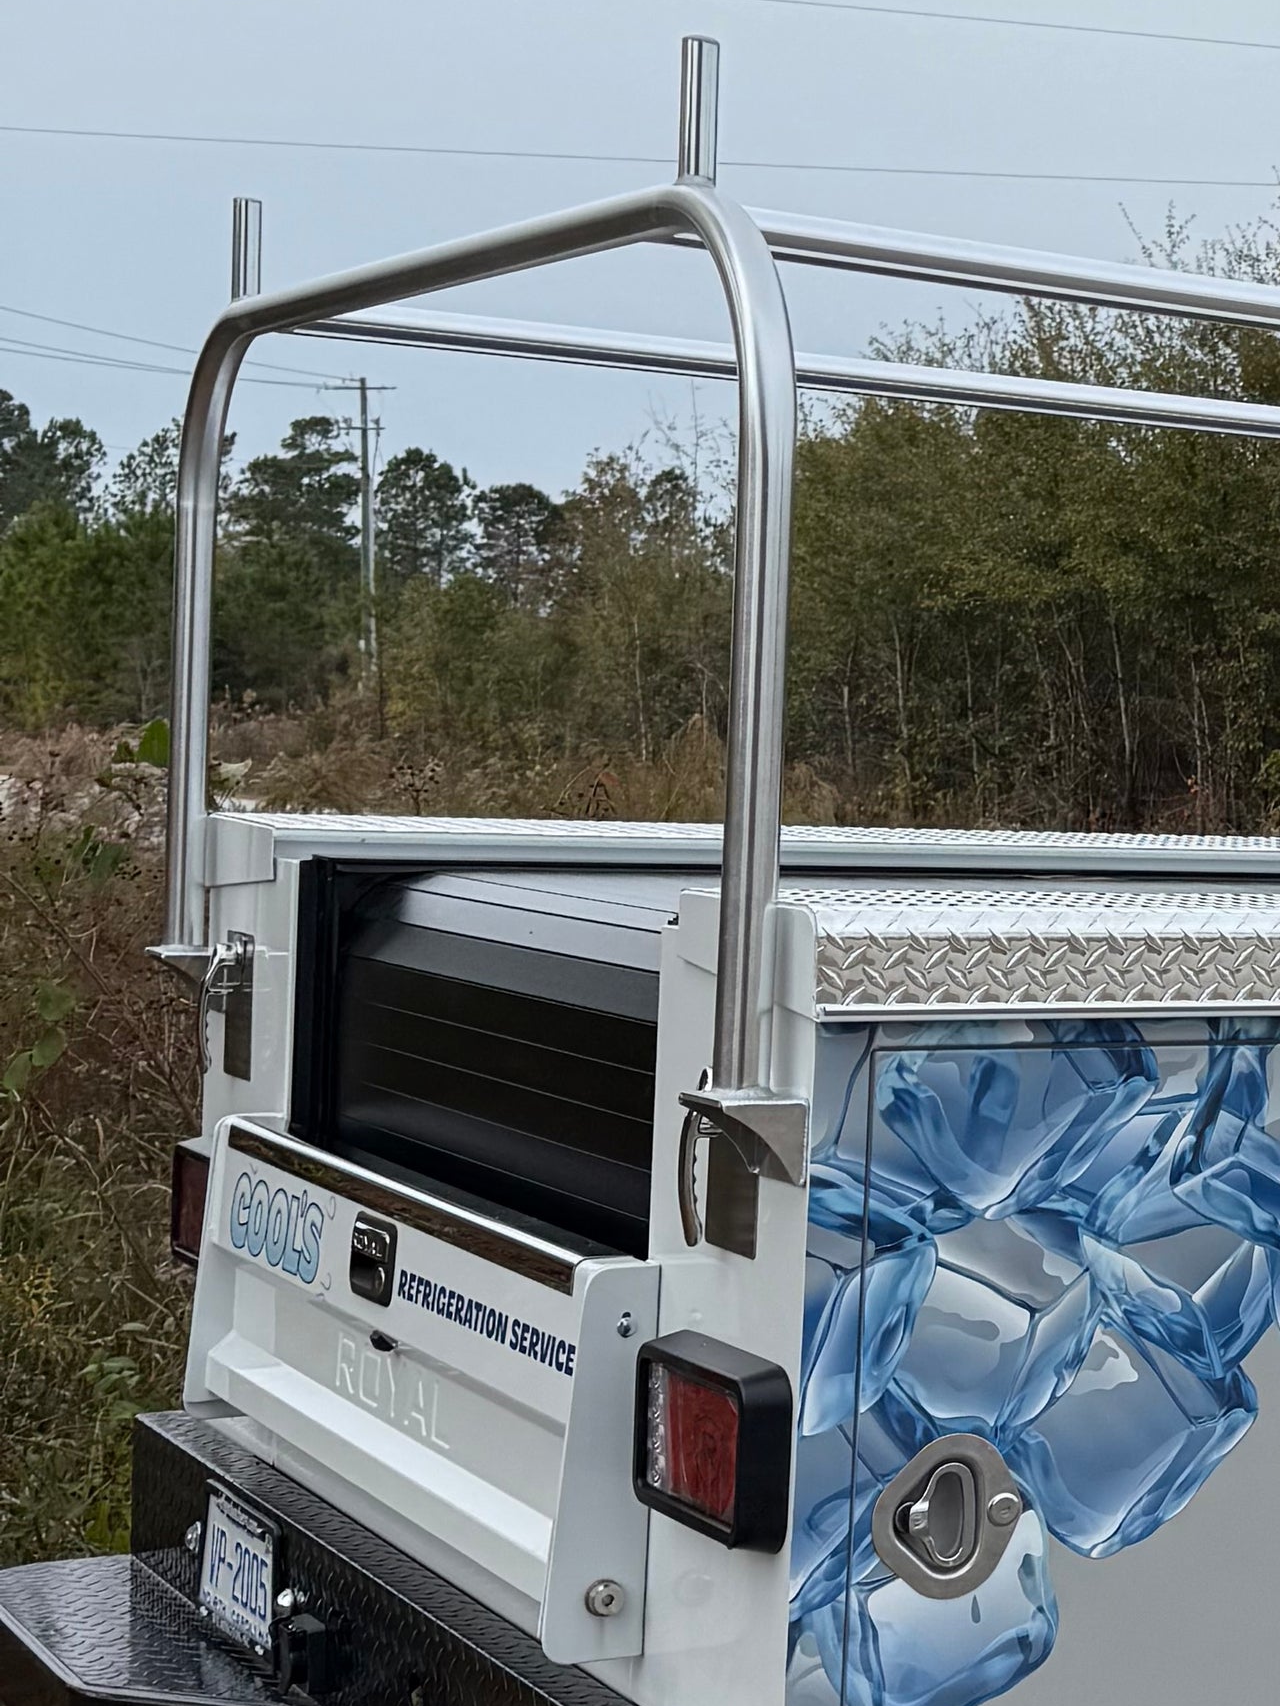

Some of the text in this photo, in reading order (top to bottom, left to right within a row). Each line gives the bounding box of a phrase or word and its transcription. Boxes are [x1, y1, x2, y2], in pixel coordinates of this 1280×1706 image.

[230, 1172, 324, 1284] COOL'S
[398, 1269, 576, 1377] REFRIGERATION SERVICE
[335, 1332, 450, 1449] ROYAL
[209, 1523, 269, 1622] VP-2005
